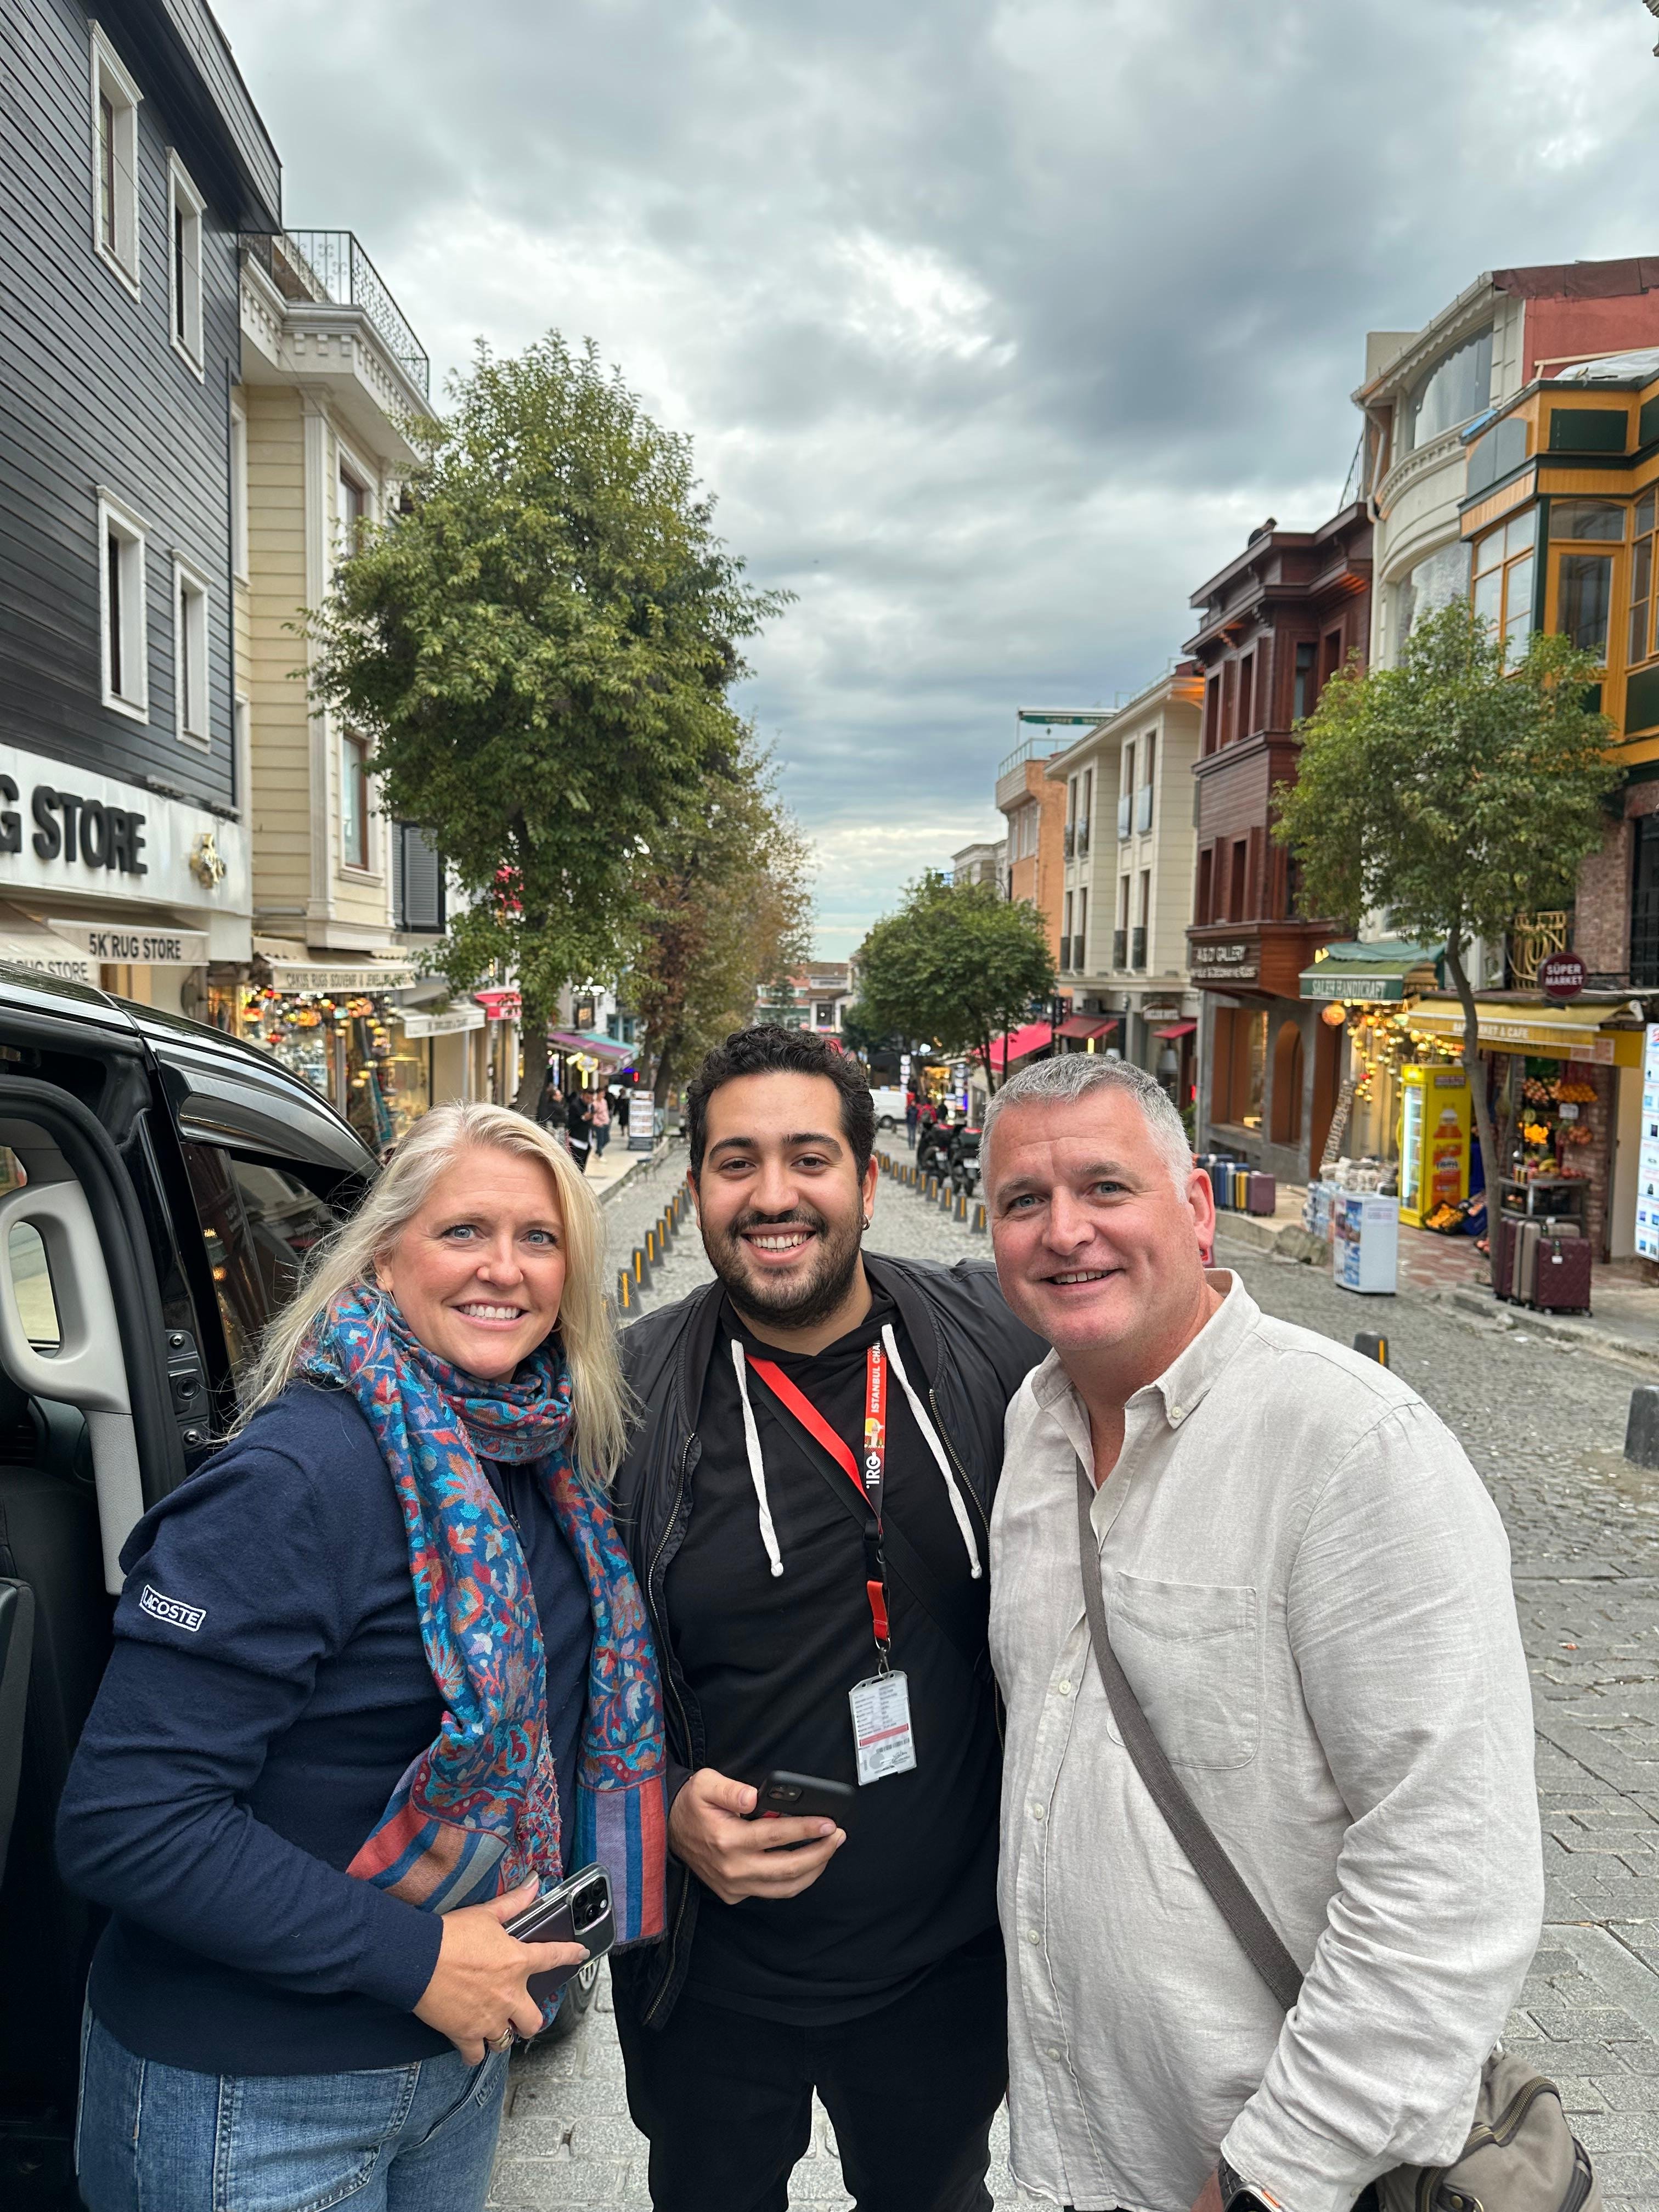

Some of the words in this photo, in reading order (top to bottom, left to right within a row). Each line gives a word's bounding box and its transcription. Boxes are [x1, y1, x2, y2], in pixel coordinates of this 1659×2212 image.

[31, 786, 148, 874] STORE
[89, 933, 108, 957] 5K
[111, 934, 139, 959] RUG
[143, 938, 182, 960] STORE
[1336, 980, 1387, 1000] HANDICRAFT
[1545, 975, 1583, 986] MARKET
[871, 1366, 881, 1413] ISTANBUL
[143, 1589, 200, 1626] LACOSTE
